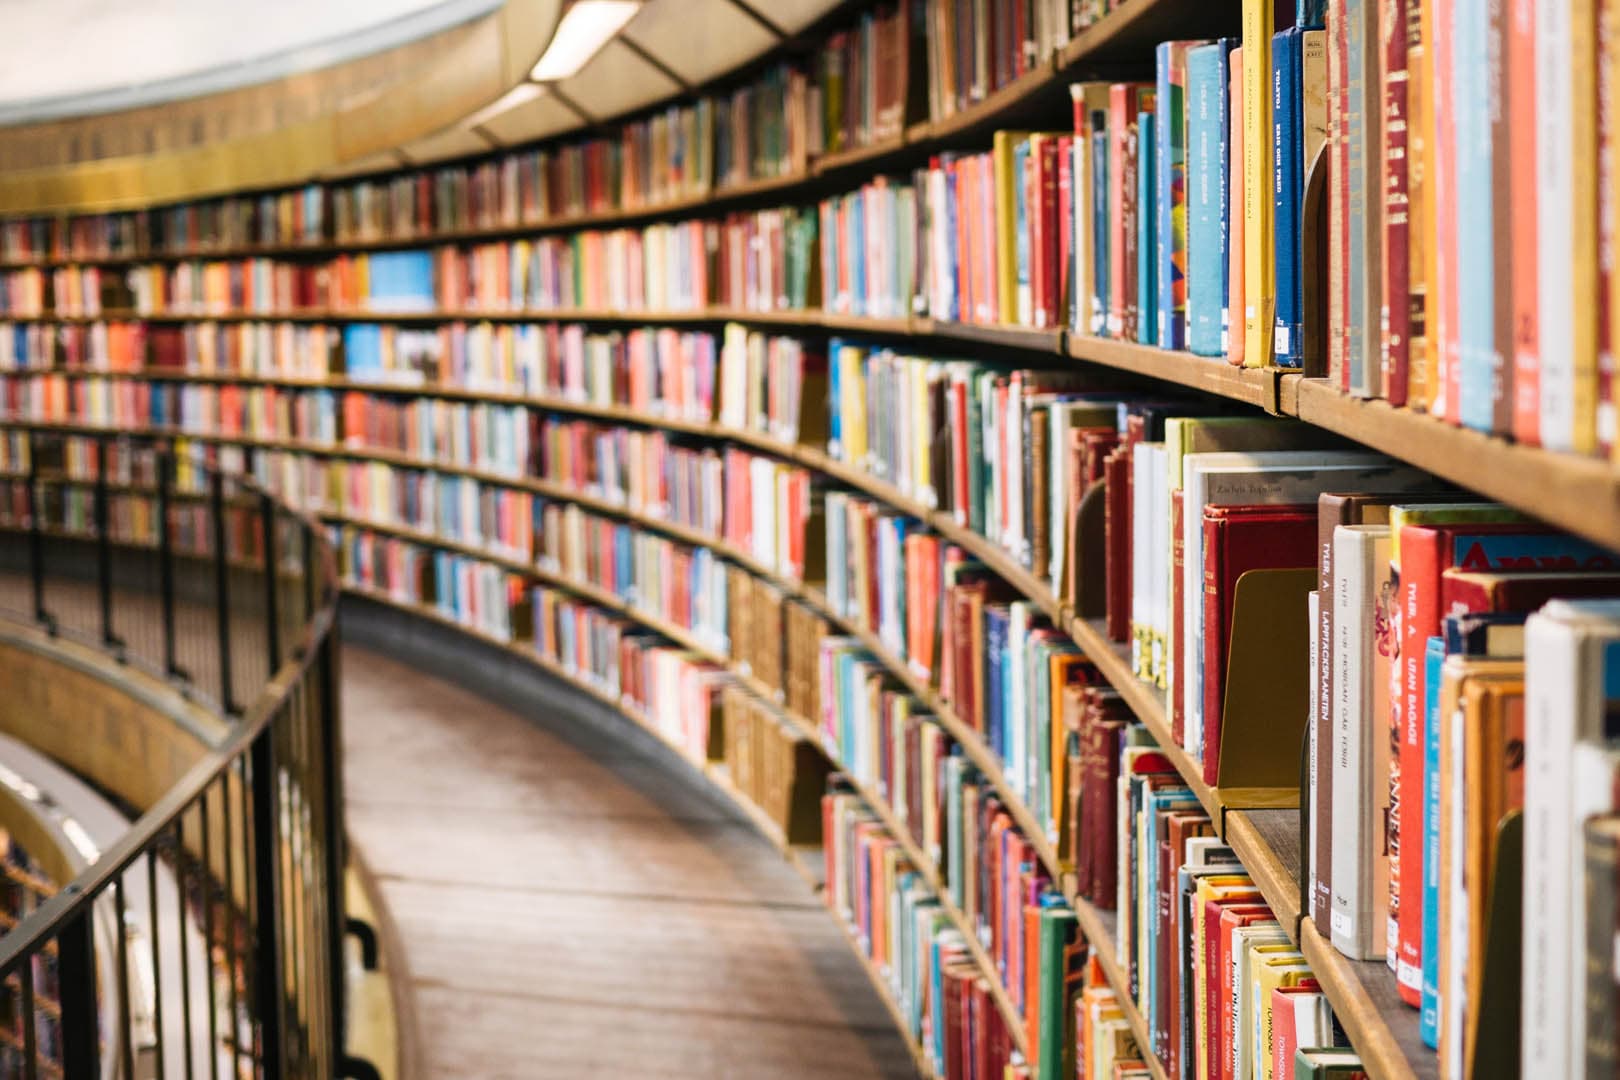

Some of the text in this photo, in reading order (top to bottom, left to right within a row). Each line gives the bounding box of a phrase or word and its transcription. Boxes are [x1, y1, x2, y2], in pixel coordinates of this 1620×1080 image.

[1321, 543, 1331, 576] TYLER,
[1406, 657, 1417, 691] UTAN
[1406, 694, 1417, 746] BAGAGE
